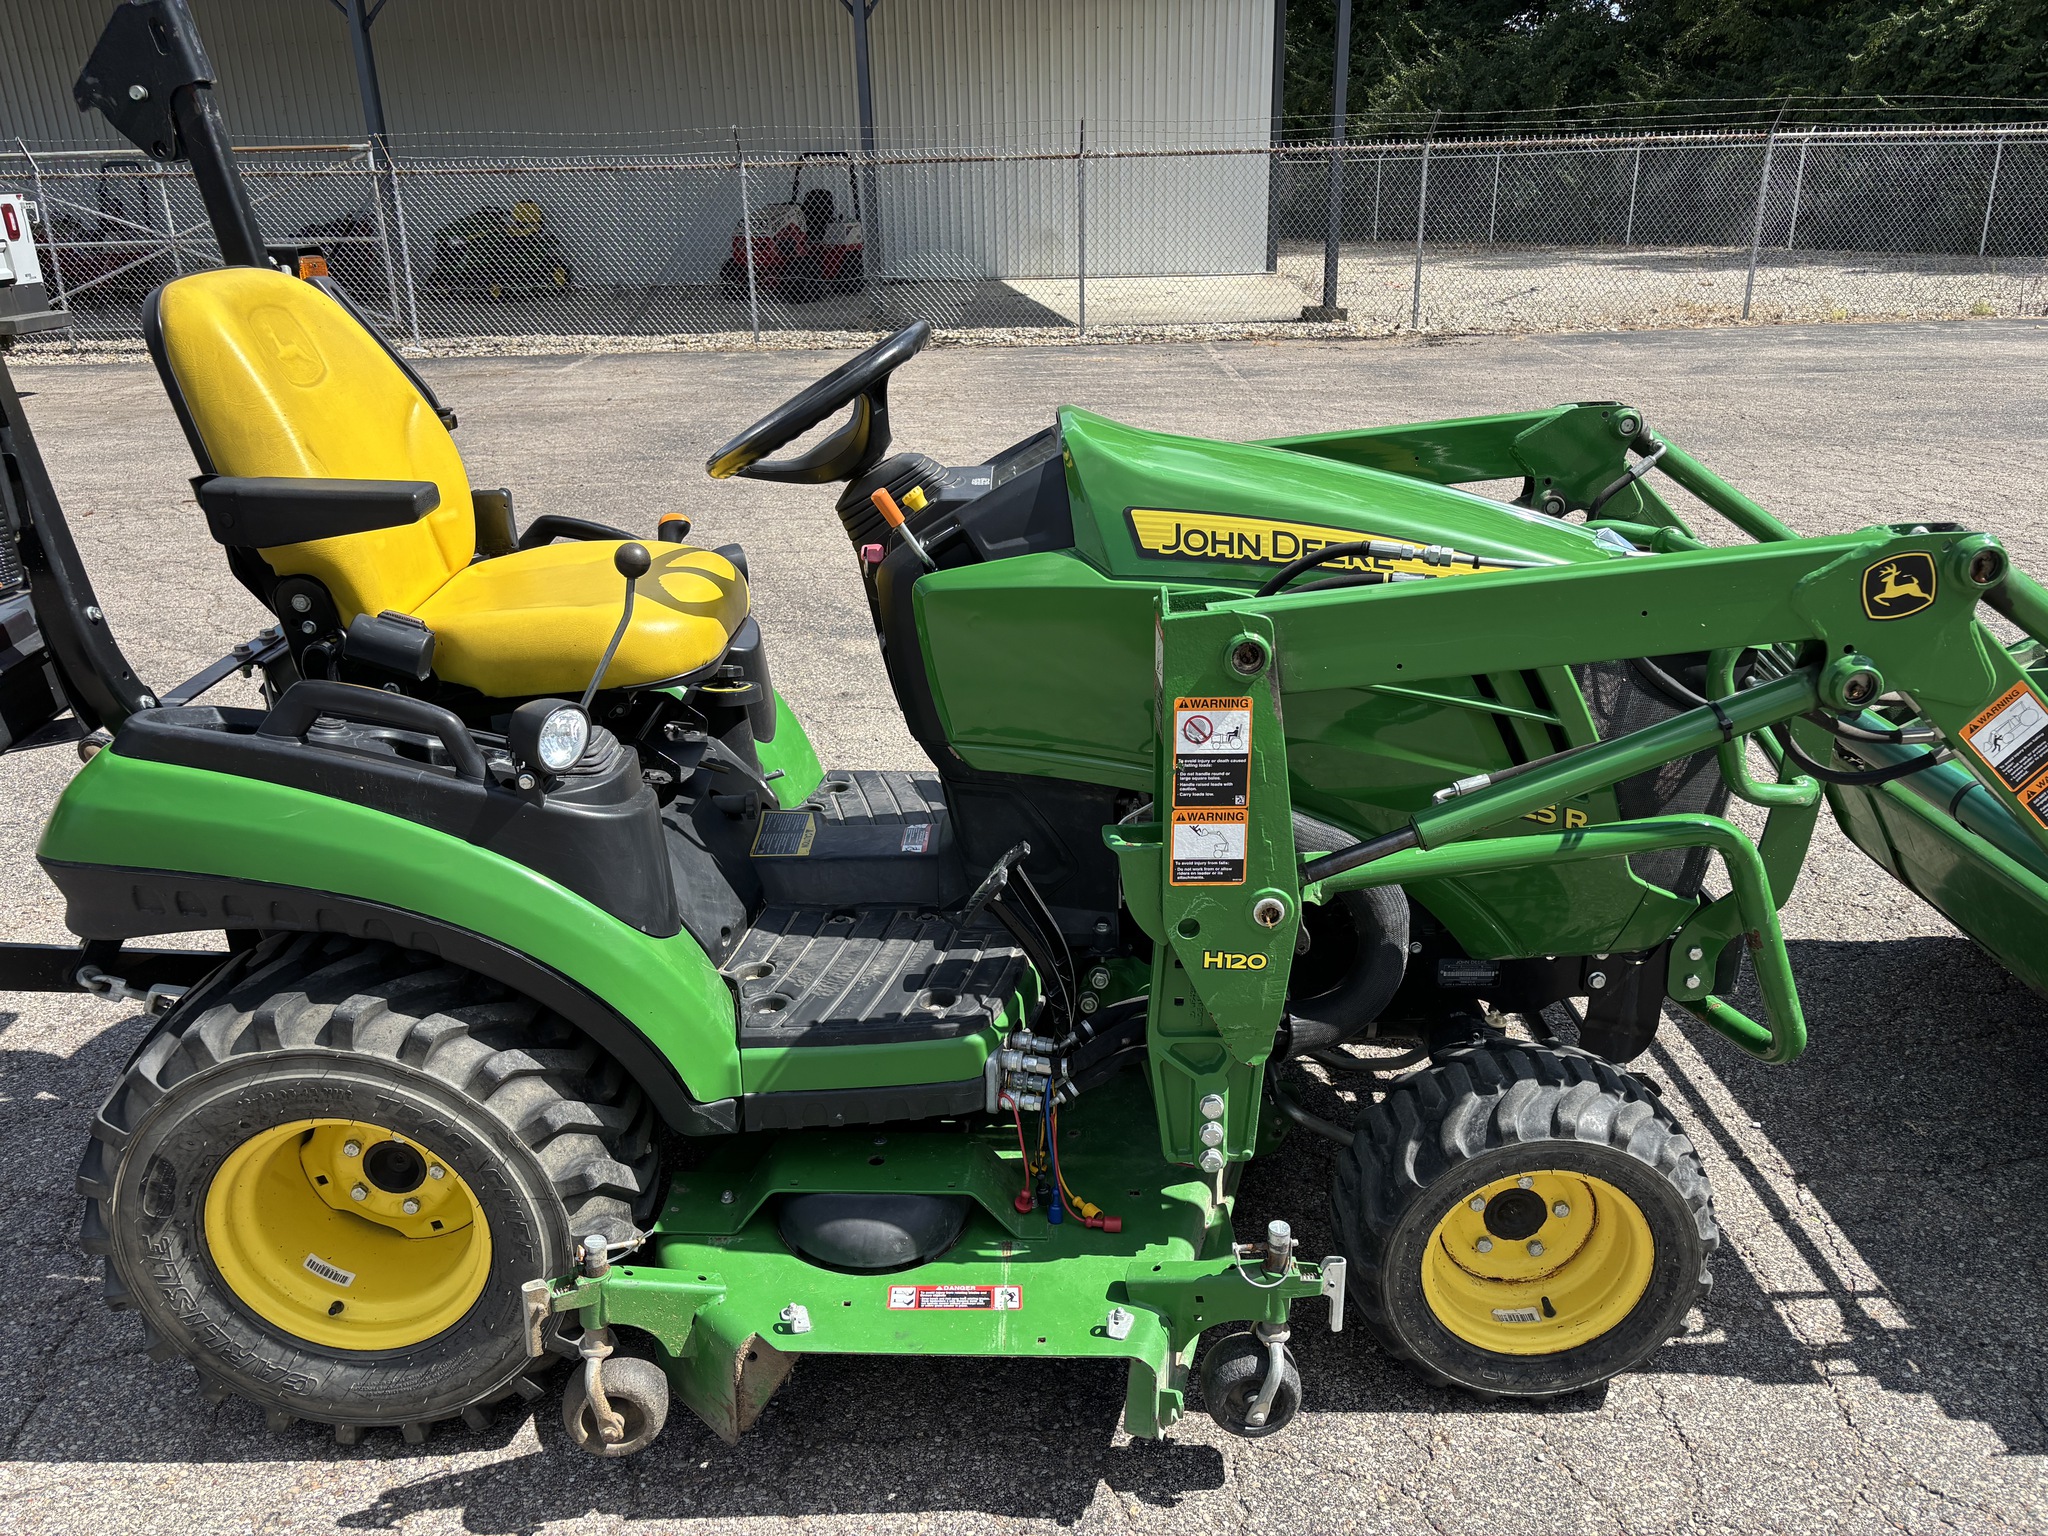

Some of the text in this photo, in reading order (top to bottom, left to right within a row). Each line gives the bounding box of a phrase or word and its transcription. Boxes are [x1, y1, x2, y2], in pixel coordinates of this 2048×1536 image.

[1162, 523, 1261, 558] JOHN
[1190, 699, 1249, 708] WARNING
[1977, 690, 2020, 724] WARNING
[1187, 812, 1244, 821] WARNING
[1203, 951, 1268, 970] H120
[480, 1168, 535, 1263] CHIEF
[142, 1234, 319, 1396] CARLISLE
